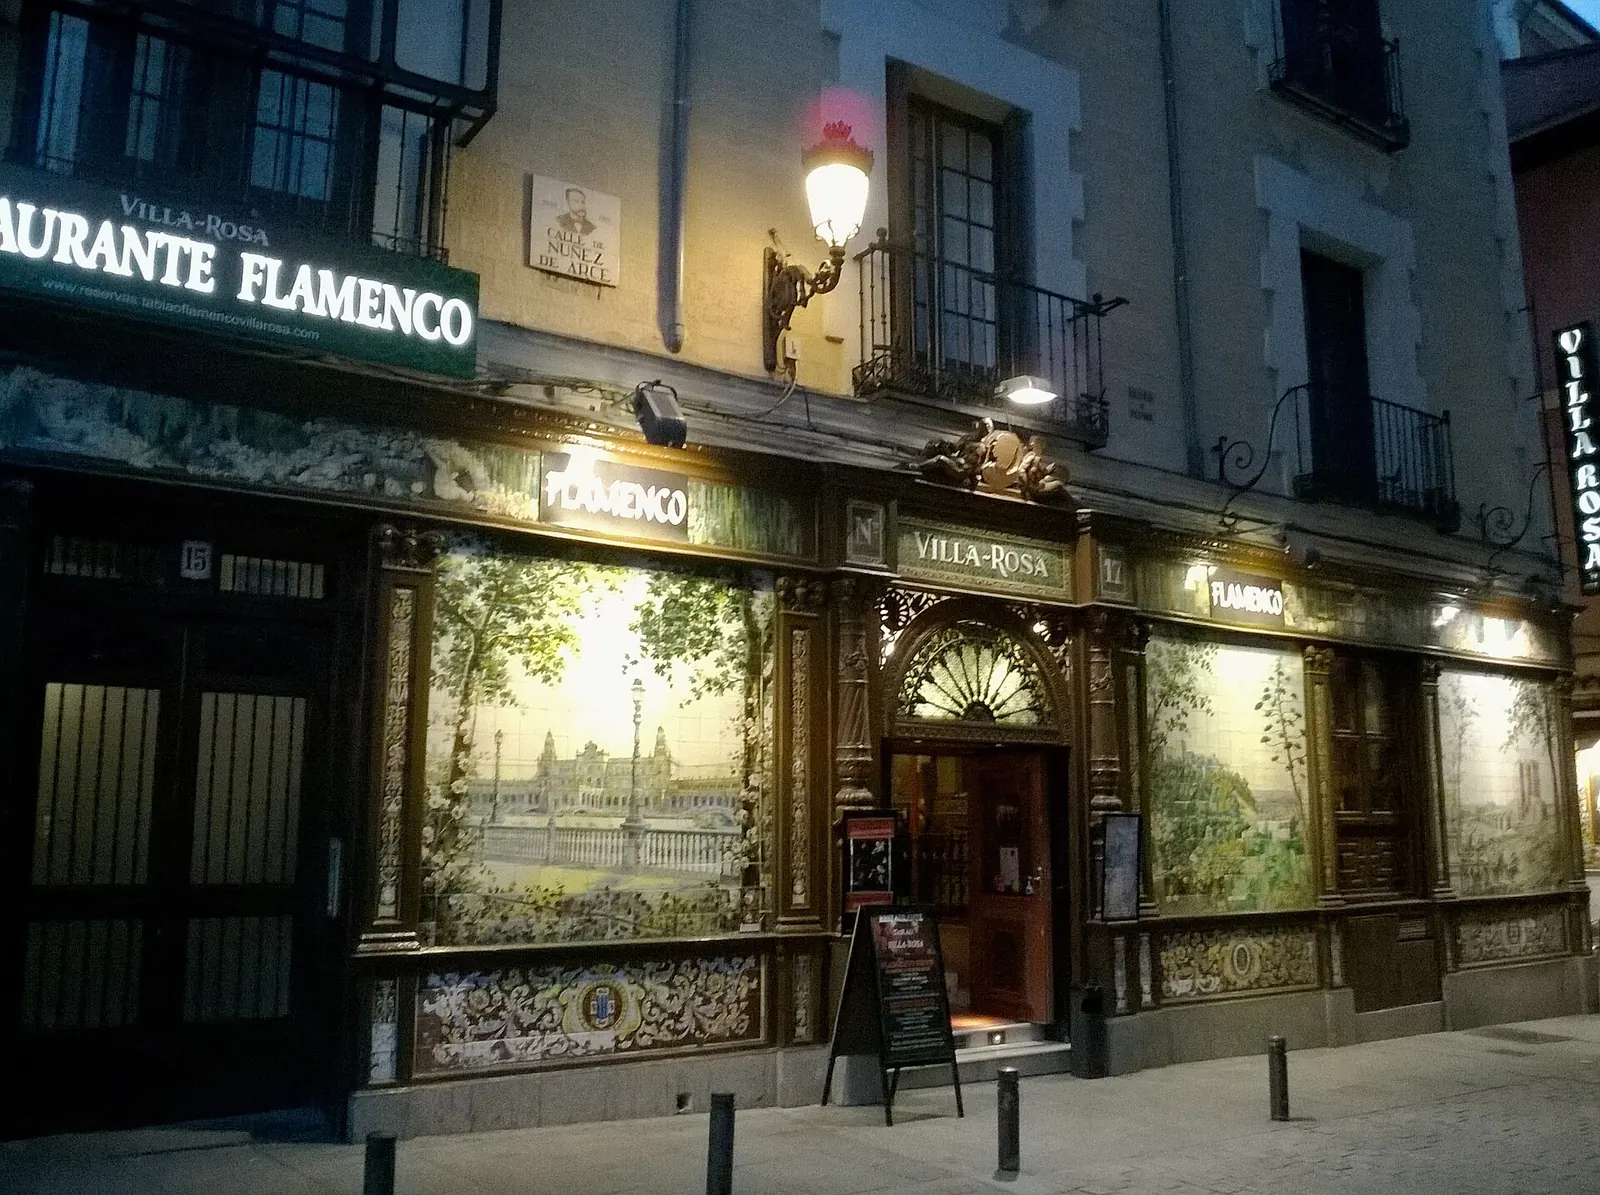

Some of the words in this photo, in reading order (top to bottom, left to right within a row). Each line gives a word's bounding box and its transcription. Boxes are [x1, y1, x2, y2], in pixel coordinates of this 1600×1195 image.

[547, 227, 586, 247] CALLE
[540, 255, 560, 269] DE
[567, 261, 611, 282] ARCE
[236, 252, 472, 345] FLAMENCO
[1560, 328, 1597, 458] VILLA
[545, 470, 687, 526] FLAMENCO
[1577, 464, 1600, 570] ROSA
[186, 547, 207, 571] 15
[915, 531, 1050, 578] VILLA-ROSA
[1103, 558, 1123, 585] 17
[1211, 581, 1283, 616] FLAMENCO
